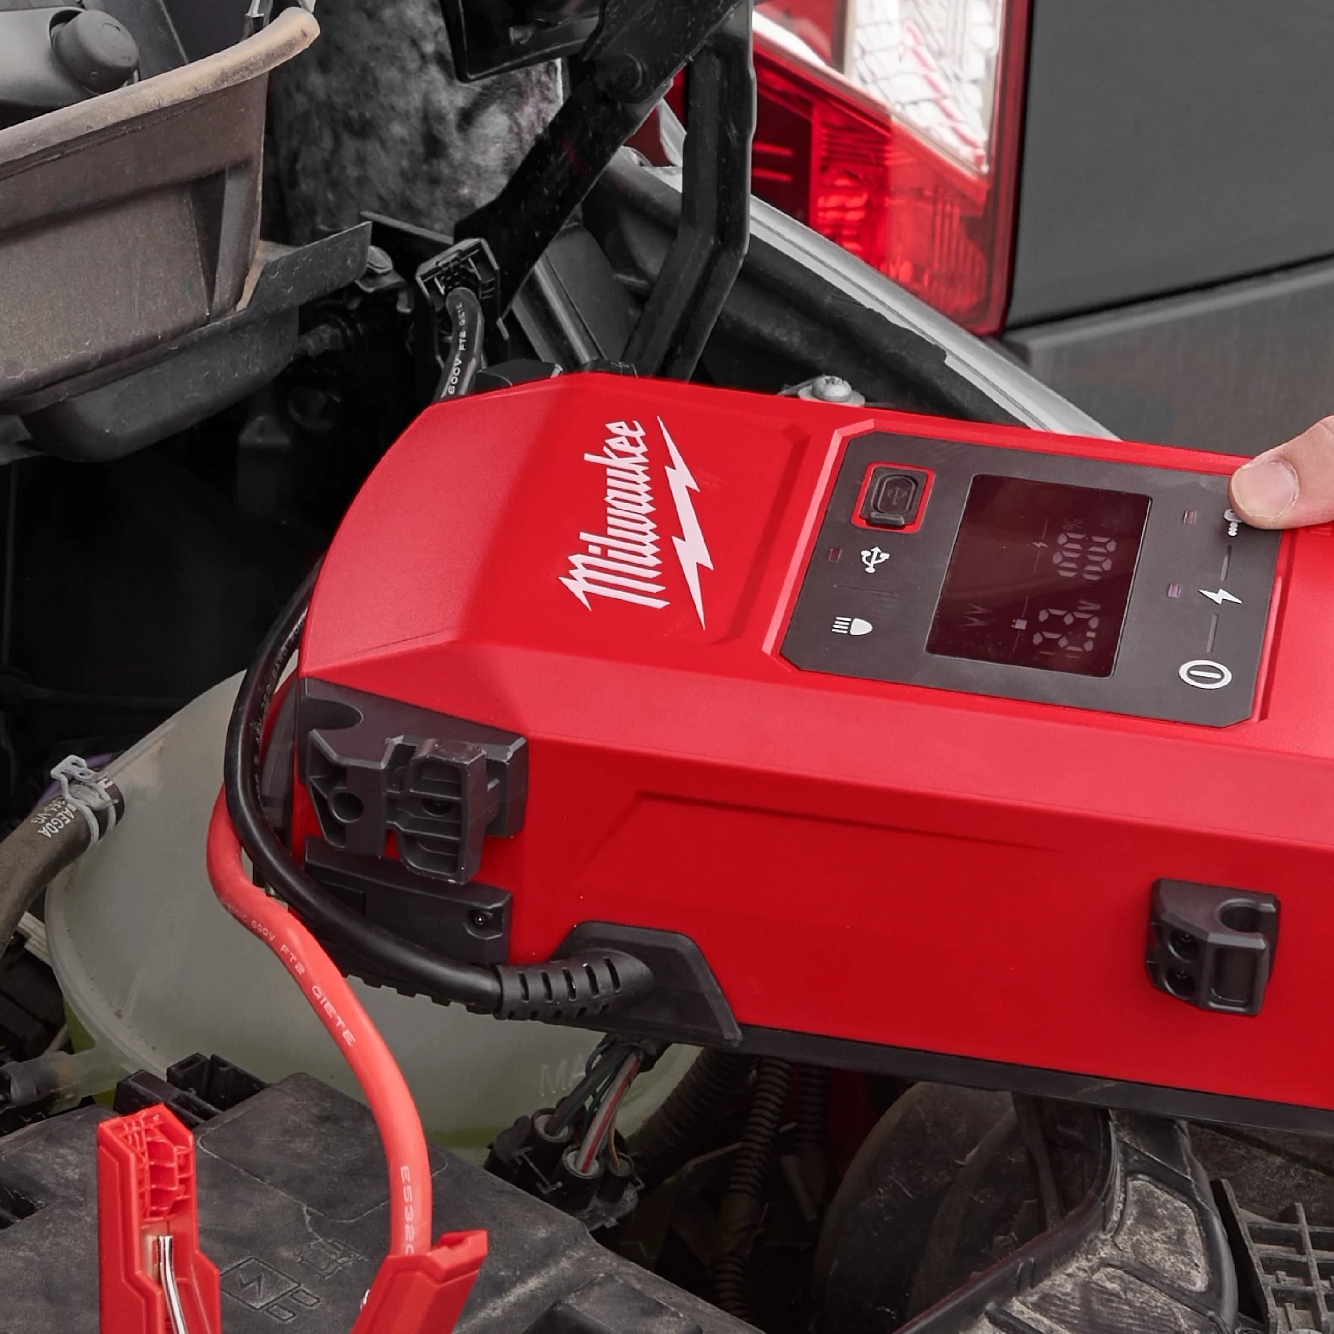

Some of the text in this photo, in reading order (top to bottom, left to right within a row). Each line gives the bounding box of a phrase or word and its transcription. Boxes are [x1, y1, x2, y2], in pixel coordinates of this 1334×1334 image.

[559, 419, 670, 611] Milwaukee
[280, 944, 306, 975] FT2
[311, 985, 356, 1047] QIETE
